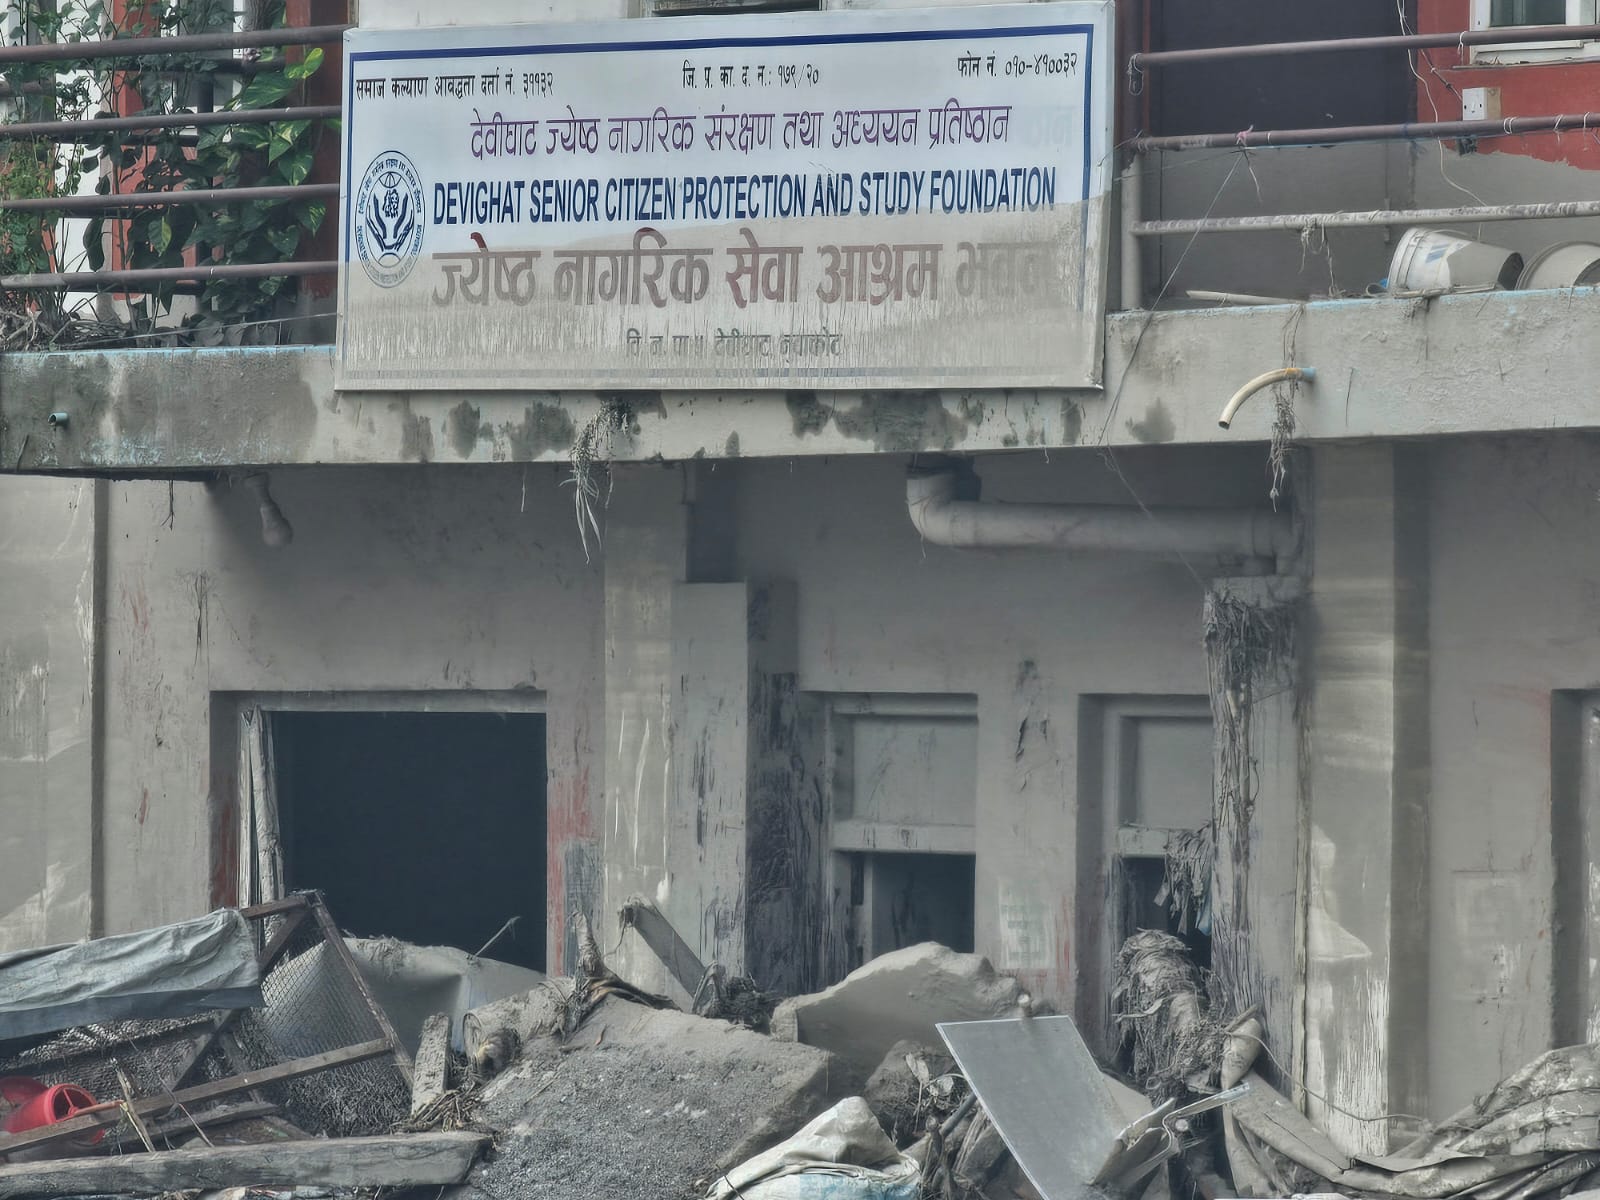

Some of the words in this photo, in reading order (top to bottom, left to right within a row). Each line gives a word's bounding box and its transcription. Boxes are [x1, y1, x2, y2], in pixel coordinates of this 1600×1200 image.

[356, 78, 386, 100] समाज
[391, 76, 428, 98] कल्याण
[481, 67, 499, 97] दर्ता
[523, 72, 553, 98] ३११३२
[682, 60, 697, 88] जि.
[719, 66, 735, 88] का.
[957, 50, 981, 77] फोन
[1005, 52, 1078, 77] ०१०-४१००३२
[470, 108, 539, 160] देवीघाट
[545, 105, 600, 154] ज्येष्ठ
[608, 106, 696, 153] नागरिक
[704, 104, 775, 155] संरक्षण
[782, 107, 824, 150] तथा
[831, 105, 921, 149] अध्ययन
[928, 97, 1012, 150] प्रतिष्ठान
[433, 180, 525, 225] DEVIGHAT
[529, 178, 599, 223] SENIOR
[605, 177, 677, 221] CITIZEN
[683, 173, 807, 220] PROTECTION
[812, 170, 854, 216] AND
[858, 170, 924, 216] STUDY
[930, 166, 1056, 215] FOUNDATION
[432, 232, 541, 307] ज्येष्ठ
[553, 227, 713, 308] नागरिक
[726, 227, 804, 309] सेवा
[816, 242, 944, 306] आश्रम
